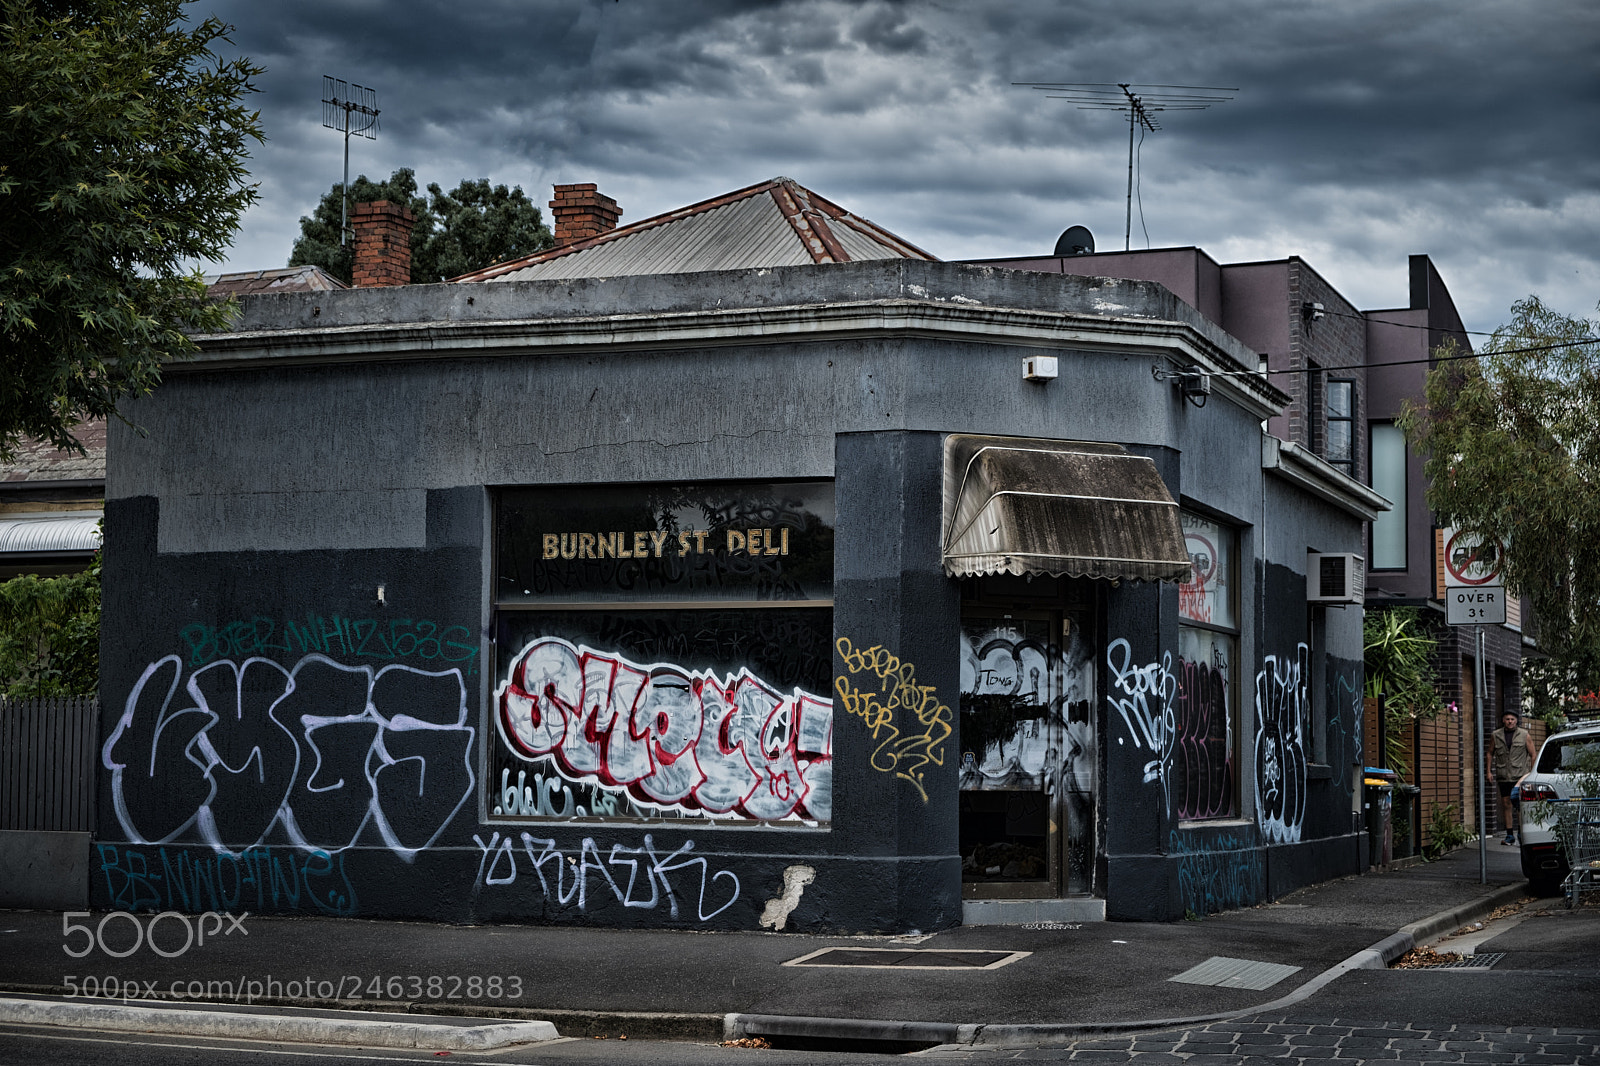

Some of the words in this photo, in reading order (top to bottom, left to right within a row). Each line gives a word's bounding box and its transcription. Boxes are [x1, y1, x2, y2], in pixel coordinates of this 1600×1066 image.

[542, 530, 668, 560] BURNLEY
[677, 530, 714, 558] ST.
[726, 527, 789, 556] DELI
[1457, 593, 1495, 604] OVER
[993, 626, 1017, 641] 115
